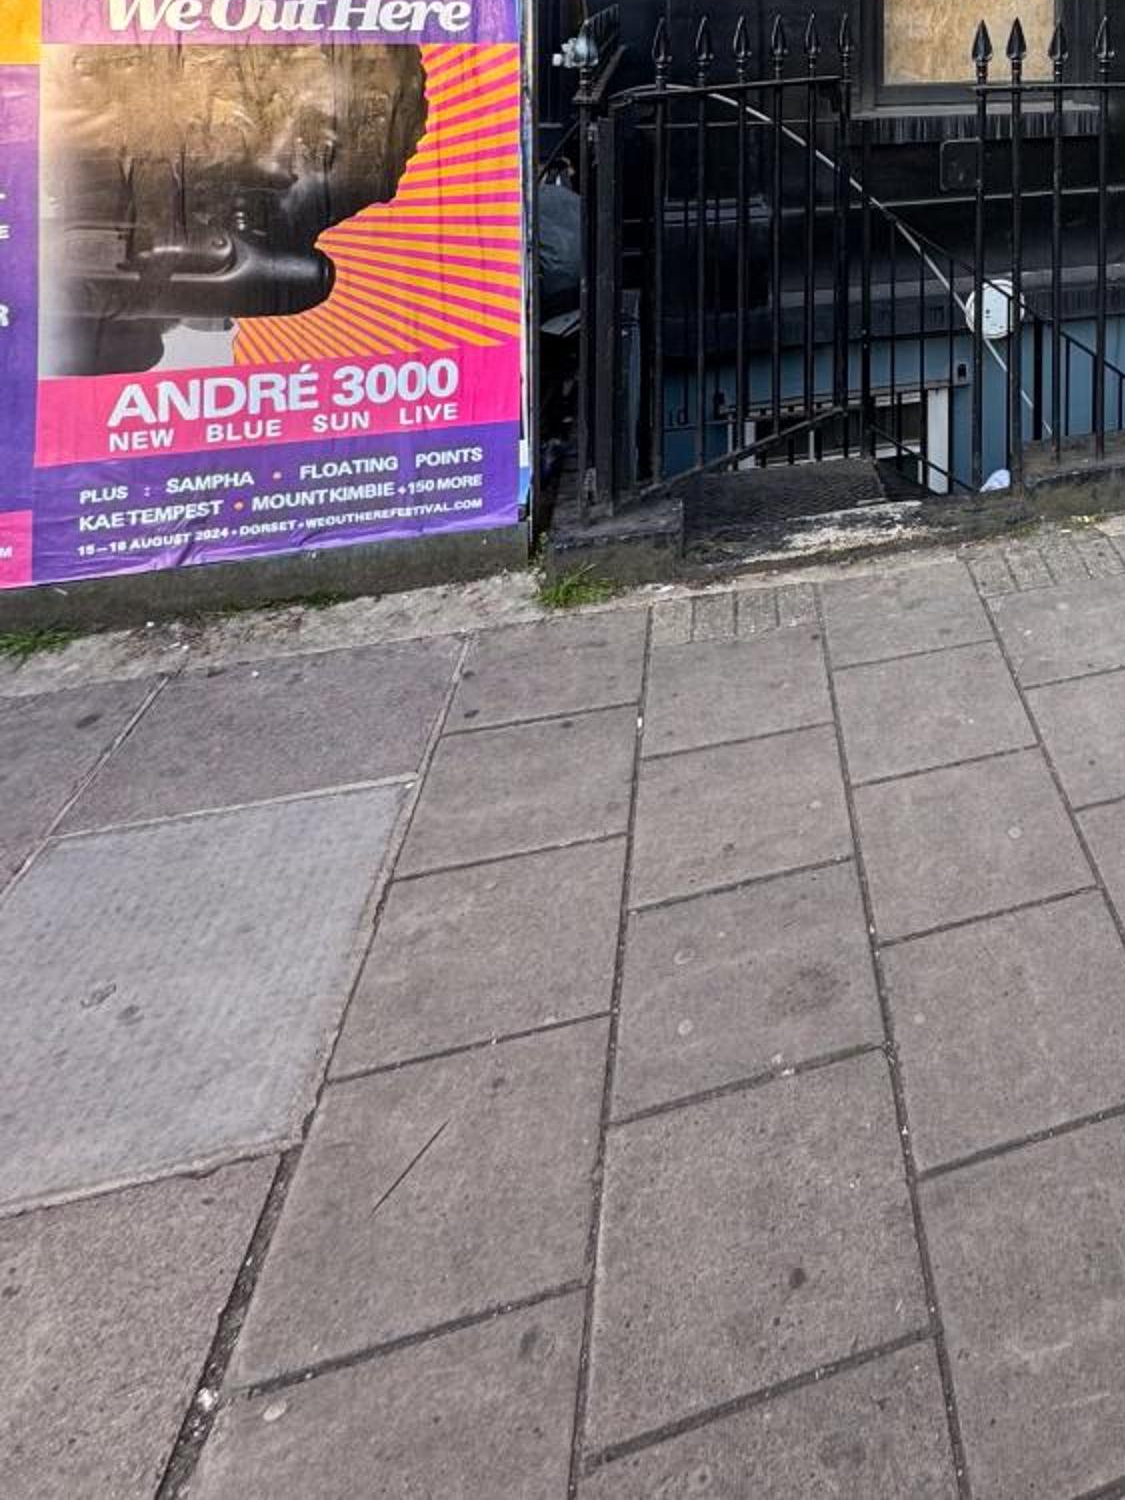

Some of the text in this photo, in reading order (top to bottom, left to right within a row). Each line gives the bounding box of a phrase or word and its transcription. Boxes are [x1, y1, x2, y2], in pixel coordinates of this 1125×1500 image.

[106, 357, 460, 428] ANDRÉ 3000
[108, 403, 459, 453] NEW BLUE SUN LIVE
[79, 486, 129, 505] PLUS
[165, 471, 254, 494] SAMPHA
[300, 457, 399, 480] FLOATING
[415, 447, 483, 468] POINTS
[79, 512, 125, 532] KAE
[127, 499, 224, 525] TEMPEST
[252, 488, 329, 511] MOUNT
[329, 482, 395, 502] KIMBIE
[437, 474, 483, 489] MORE
[129, 531, 192, 551] AUGUST
[195, 527, 228, 541] 2024
[239, 520, 297, 537] DORSET
